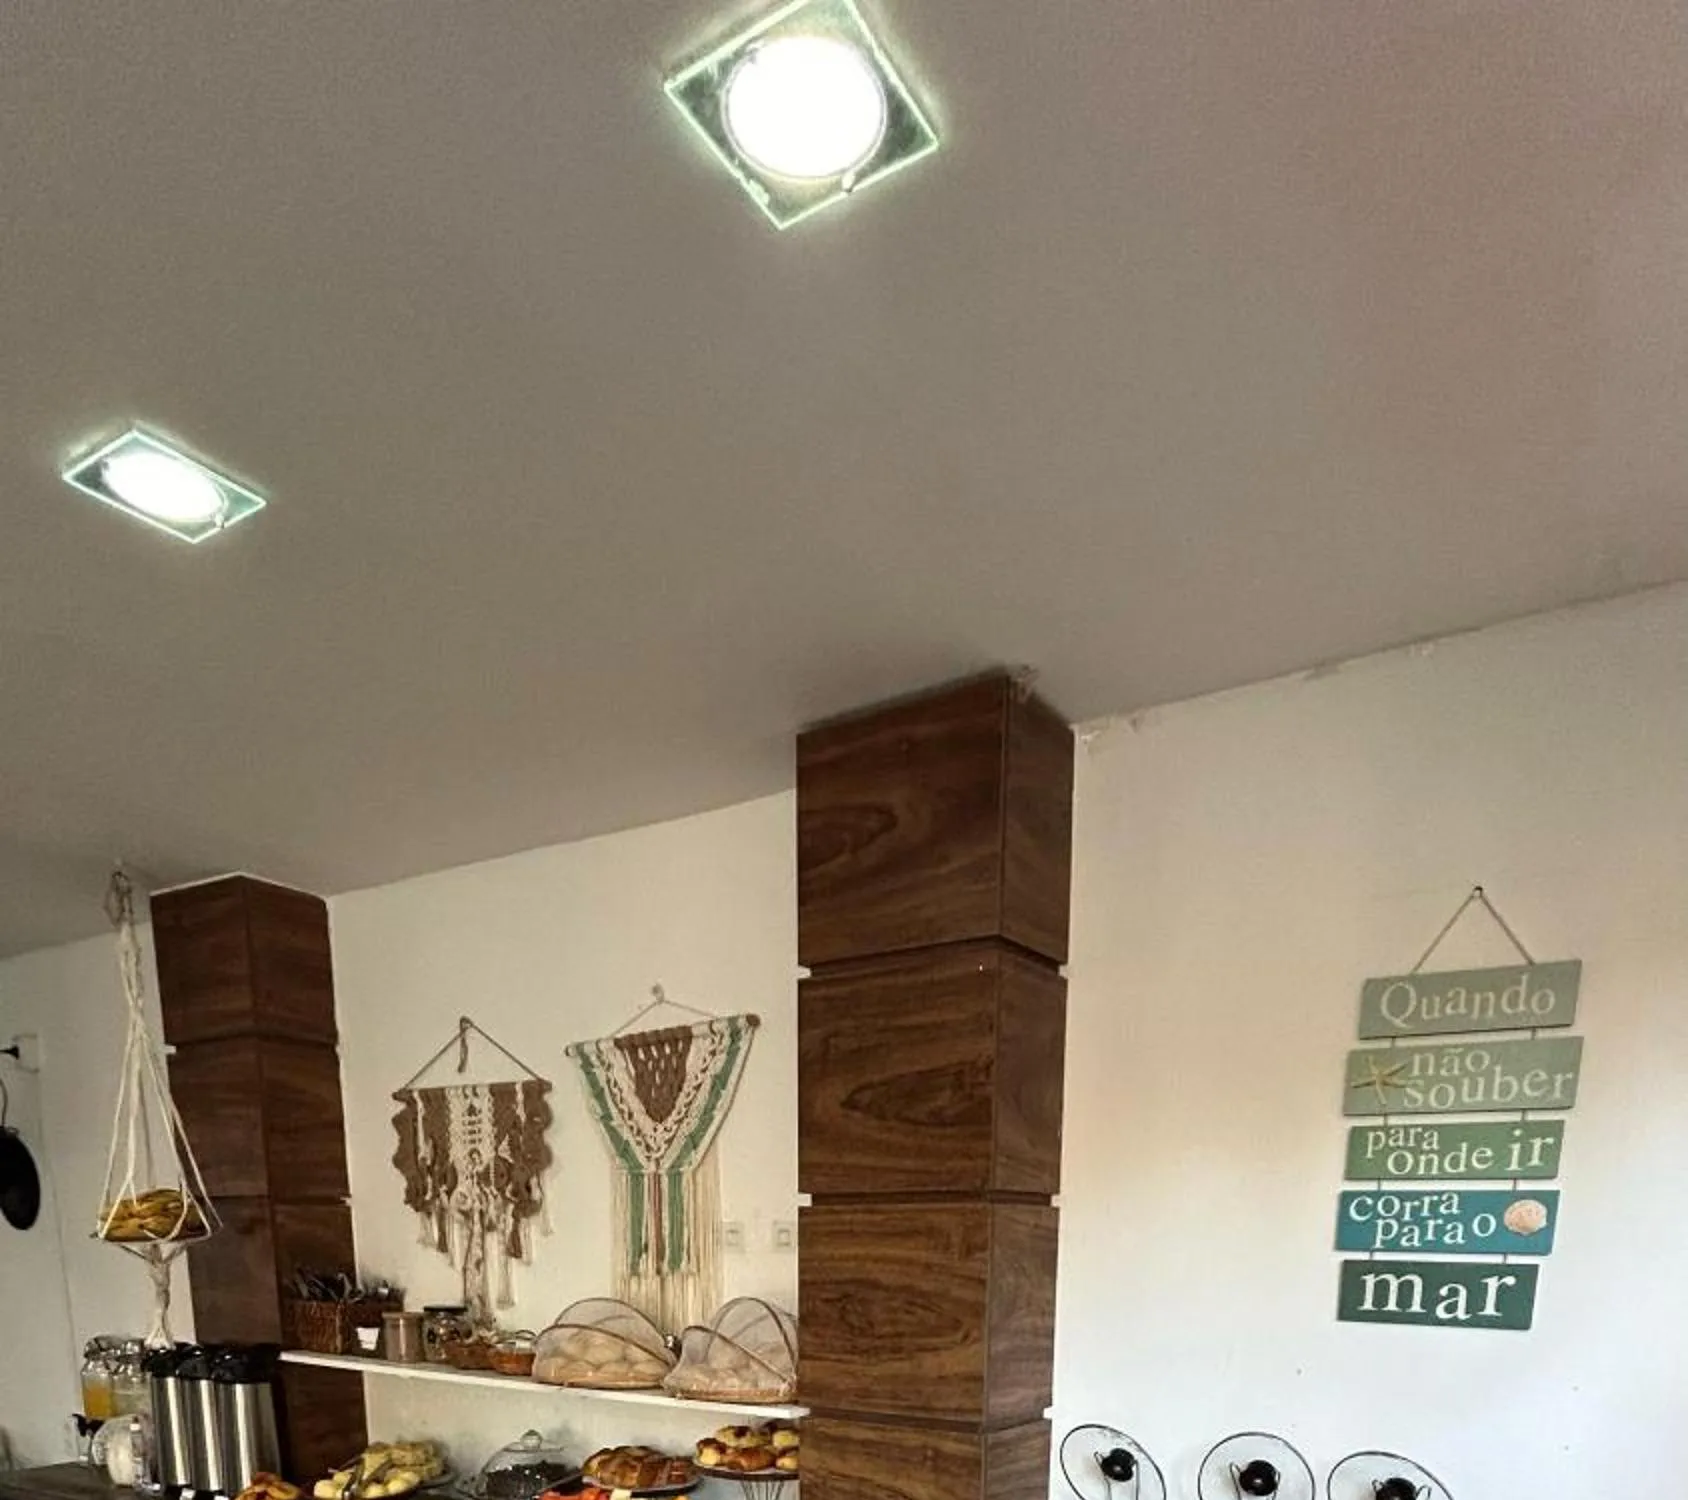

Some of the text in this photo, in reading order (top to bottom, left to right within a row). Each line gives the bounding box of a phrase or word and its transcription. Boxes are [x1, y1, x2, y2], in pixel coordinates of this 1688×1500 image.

[1380, 973, 1556, 1029] Quando
[1410, 1047, 1491, 1078] não
[1402, 1065, 1575, 1110] souber
[1366, 1125, 1441, 1159] para
[1387, 1128, 1555, 1176] onde ir
[1349, 1191, 1462, 1222] corra
[1374, 1213, 1497, 1250] para o
[1357, 1271, 1517, 1322] mar
